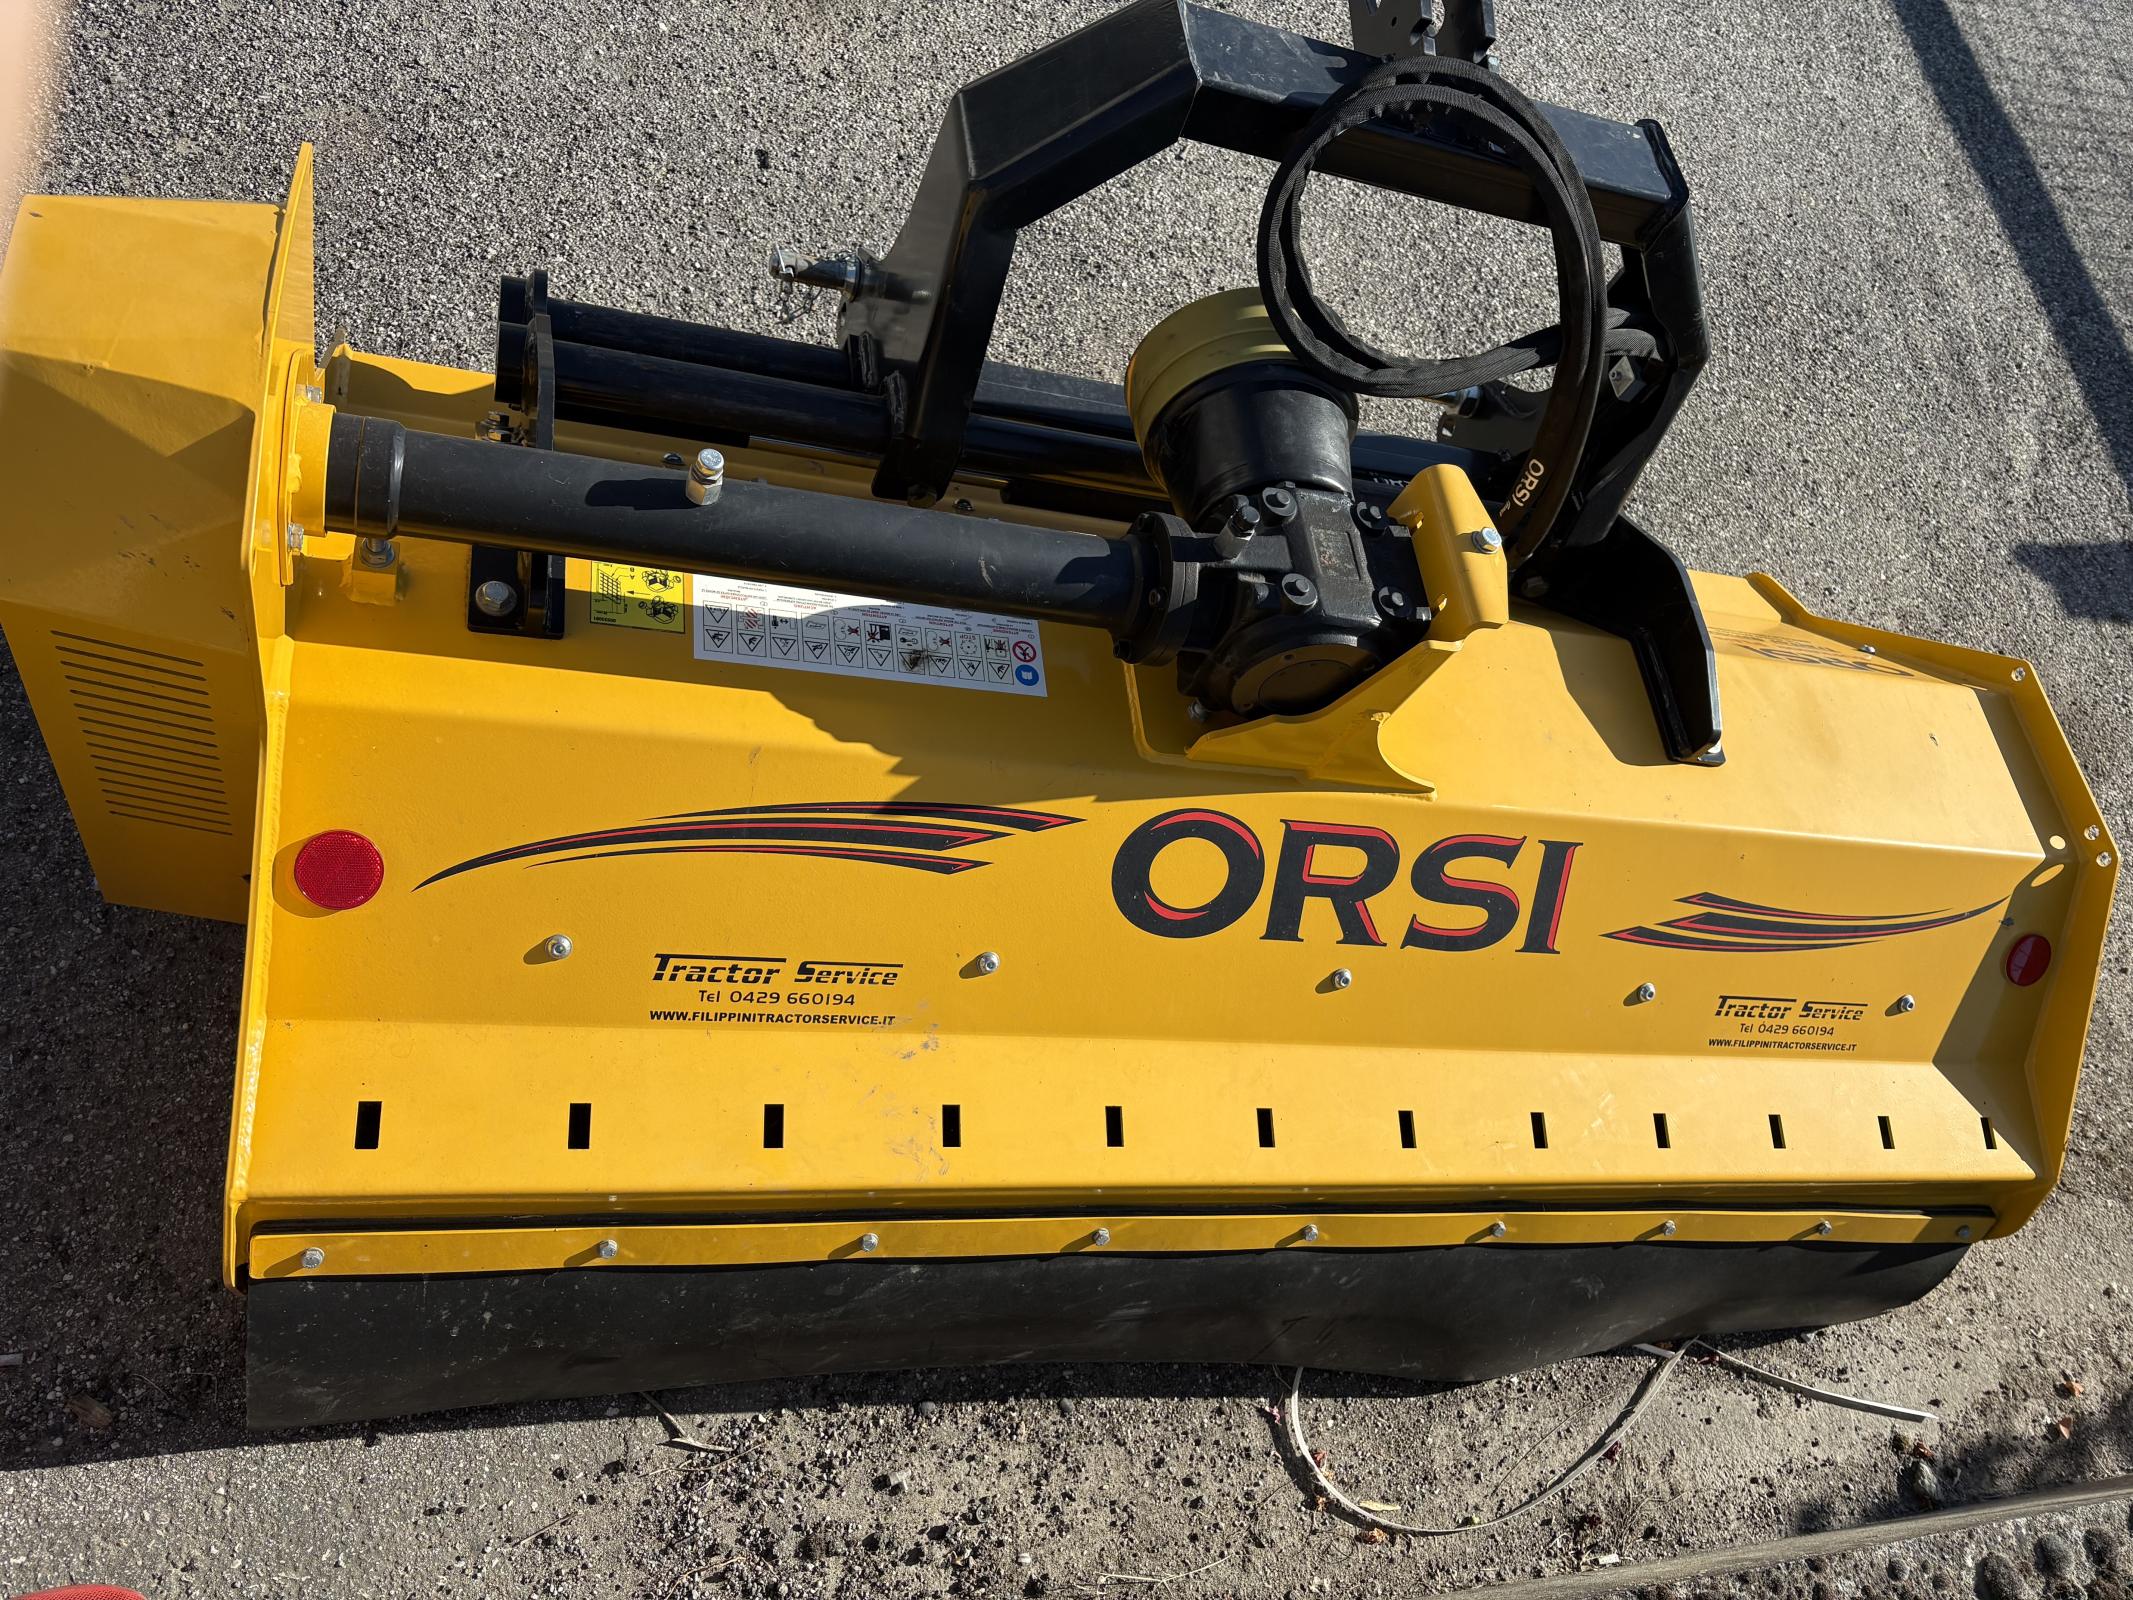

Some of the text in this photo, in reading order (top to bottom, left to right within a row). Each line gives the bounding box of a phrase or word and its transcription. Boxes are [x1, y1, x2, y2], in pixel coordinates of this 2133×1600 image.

[1512, 459, 1544, 507] ORSI
[1111, 807, 1584, 954] ORSI
[652, 953, 904, 986] Tractor Service
[698, 989, 856, 1006] Tel 0429 660194
[1715, 995, 1868, 1021] Tractor Service
[649, 1010, 896, 1026] WWW.FILIPPINITRACTORSERVICE.IT
[1740, 1023, 1835, 1037] Tel 0429 660194
[1708, 1038, 1857, 1052] WWW.FILIPPINITRACTORSERVICE.IT
